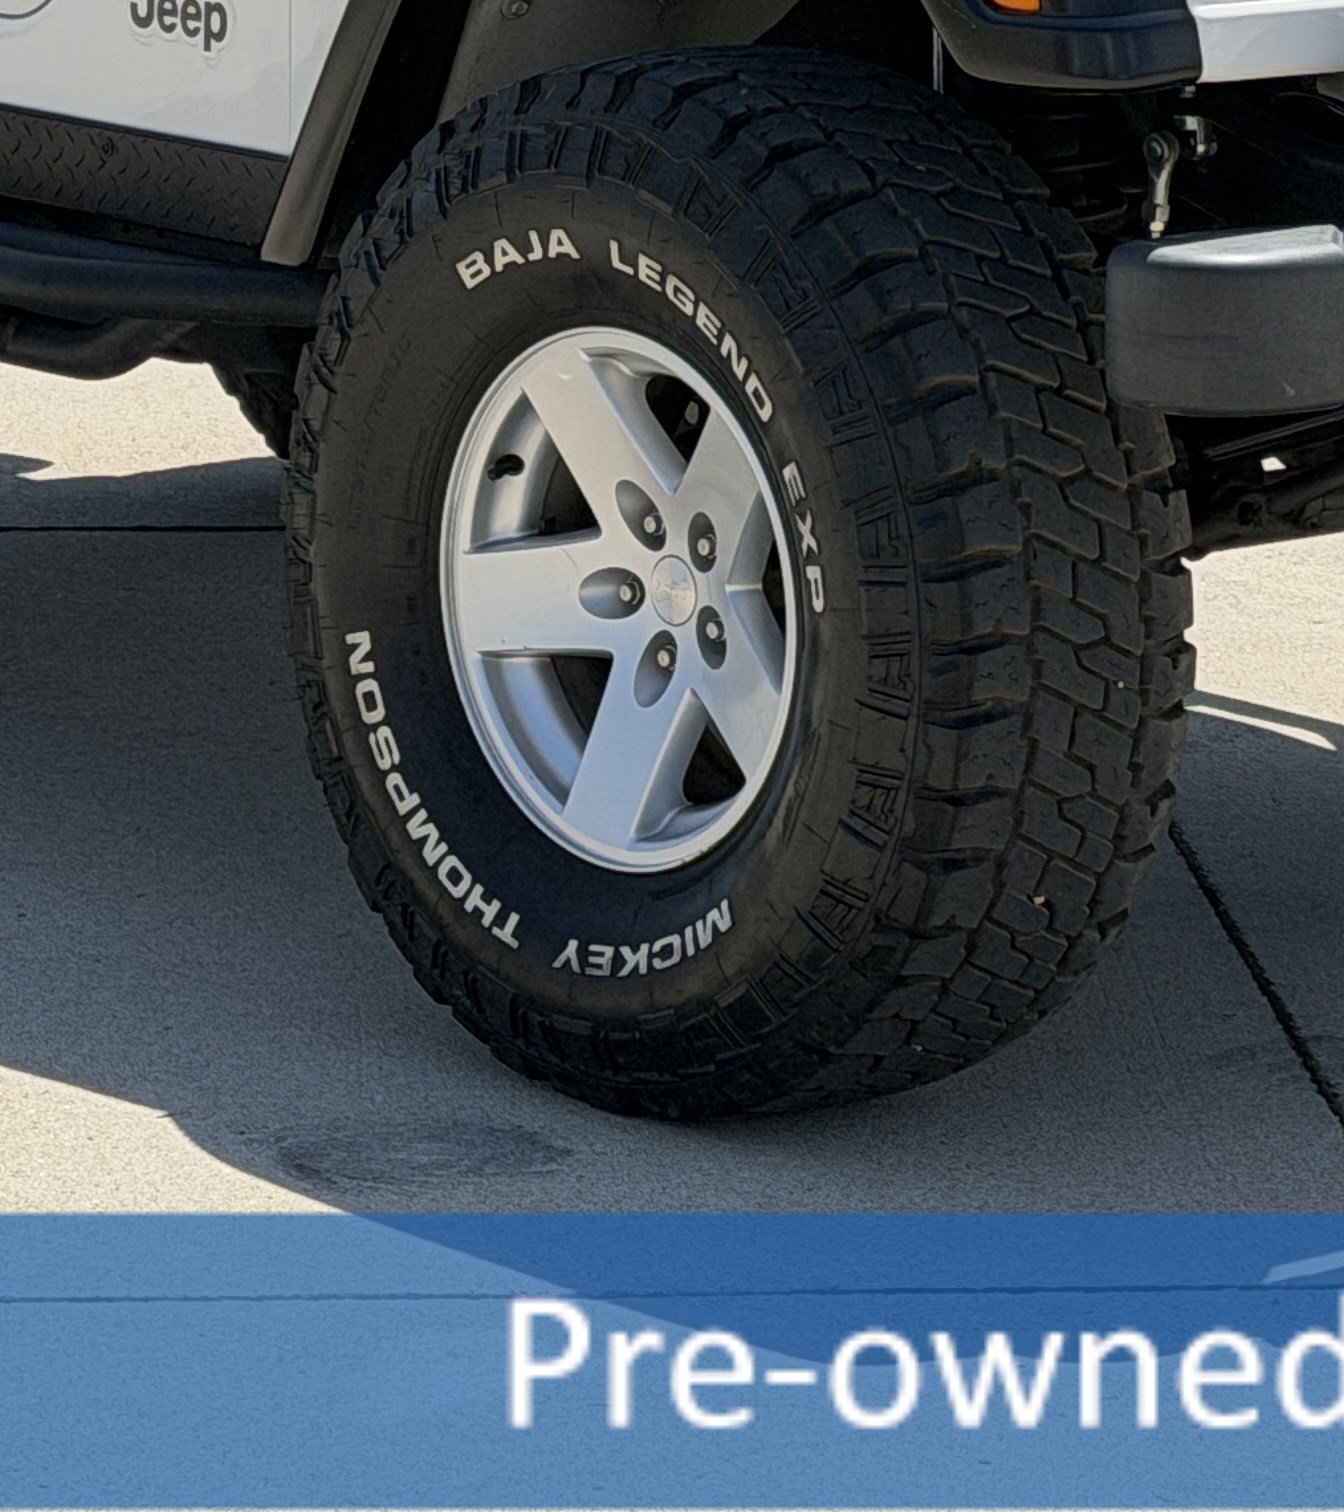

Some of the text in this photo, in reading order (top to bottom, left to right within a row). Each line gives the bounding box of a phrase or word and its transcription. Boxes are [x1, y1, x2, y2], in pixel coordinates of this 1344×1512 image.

[456, 228, 825, 614] BAJA LEGEND EXP
[345, 630, 734, 978] MICKEY THOMPSON
